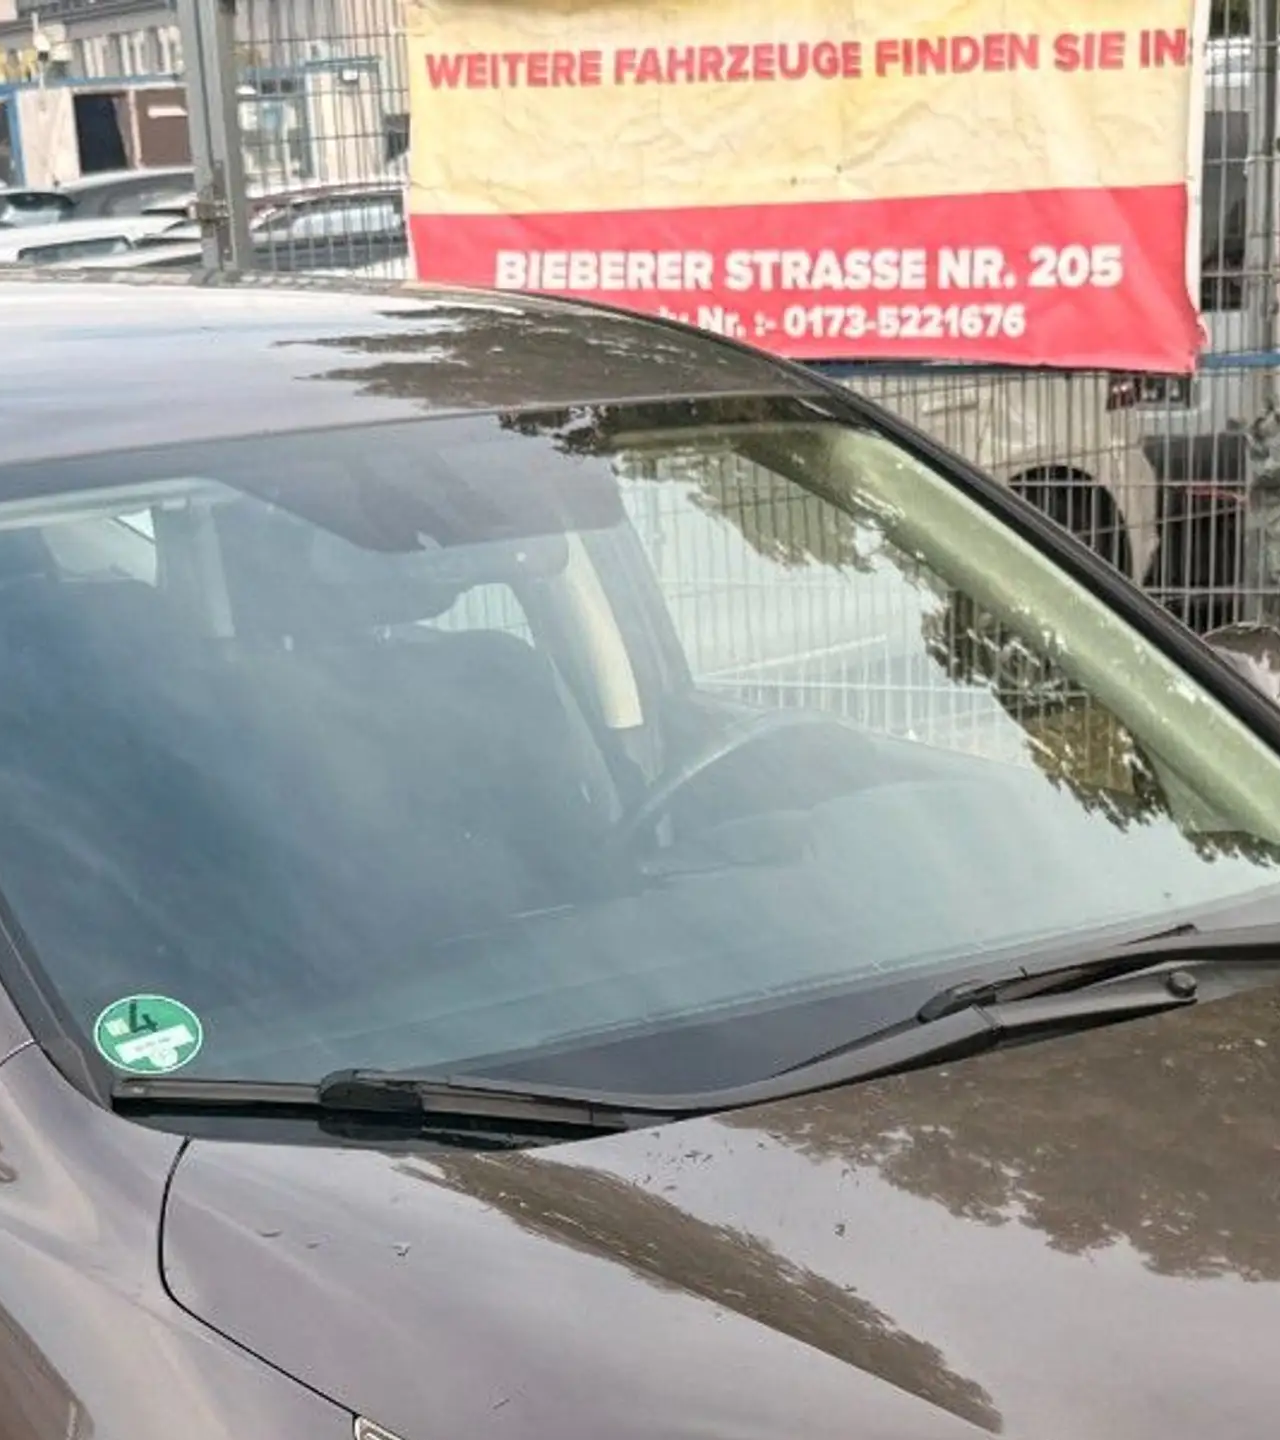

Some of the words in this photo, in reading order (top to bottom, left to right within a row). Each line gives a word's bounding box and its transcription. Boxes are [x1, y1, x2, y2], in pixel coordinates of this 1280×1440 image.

[425, 49, 603, 90] WEITERE
[613, 41, 863, 86] FAHRZEUGE
[874, 32, 1040, 78] FINDEN
[1053, 30, 1127, 73] SIE
[495, 249, 714, 290] BIEBERER
[724, 247, 927, 290] STRASSE
[937, 246, 1018, 290] NR.
[1028, 243, 1124, 288] 205
[697, 304, 747, 338] Nr.
[783, 303, 1026, 338] 0173-5221676
